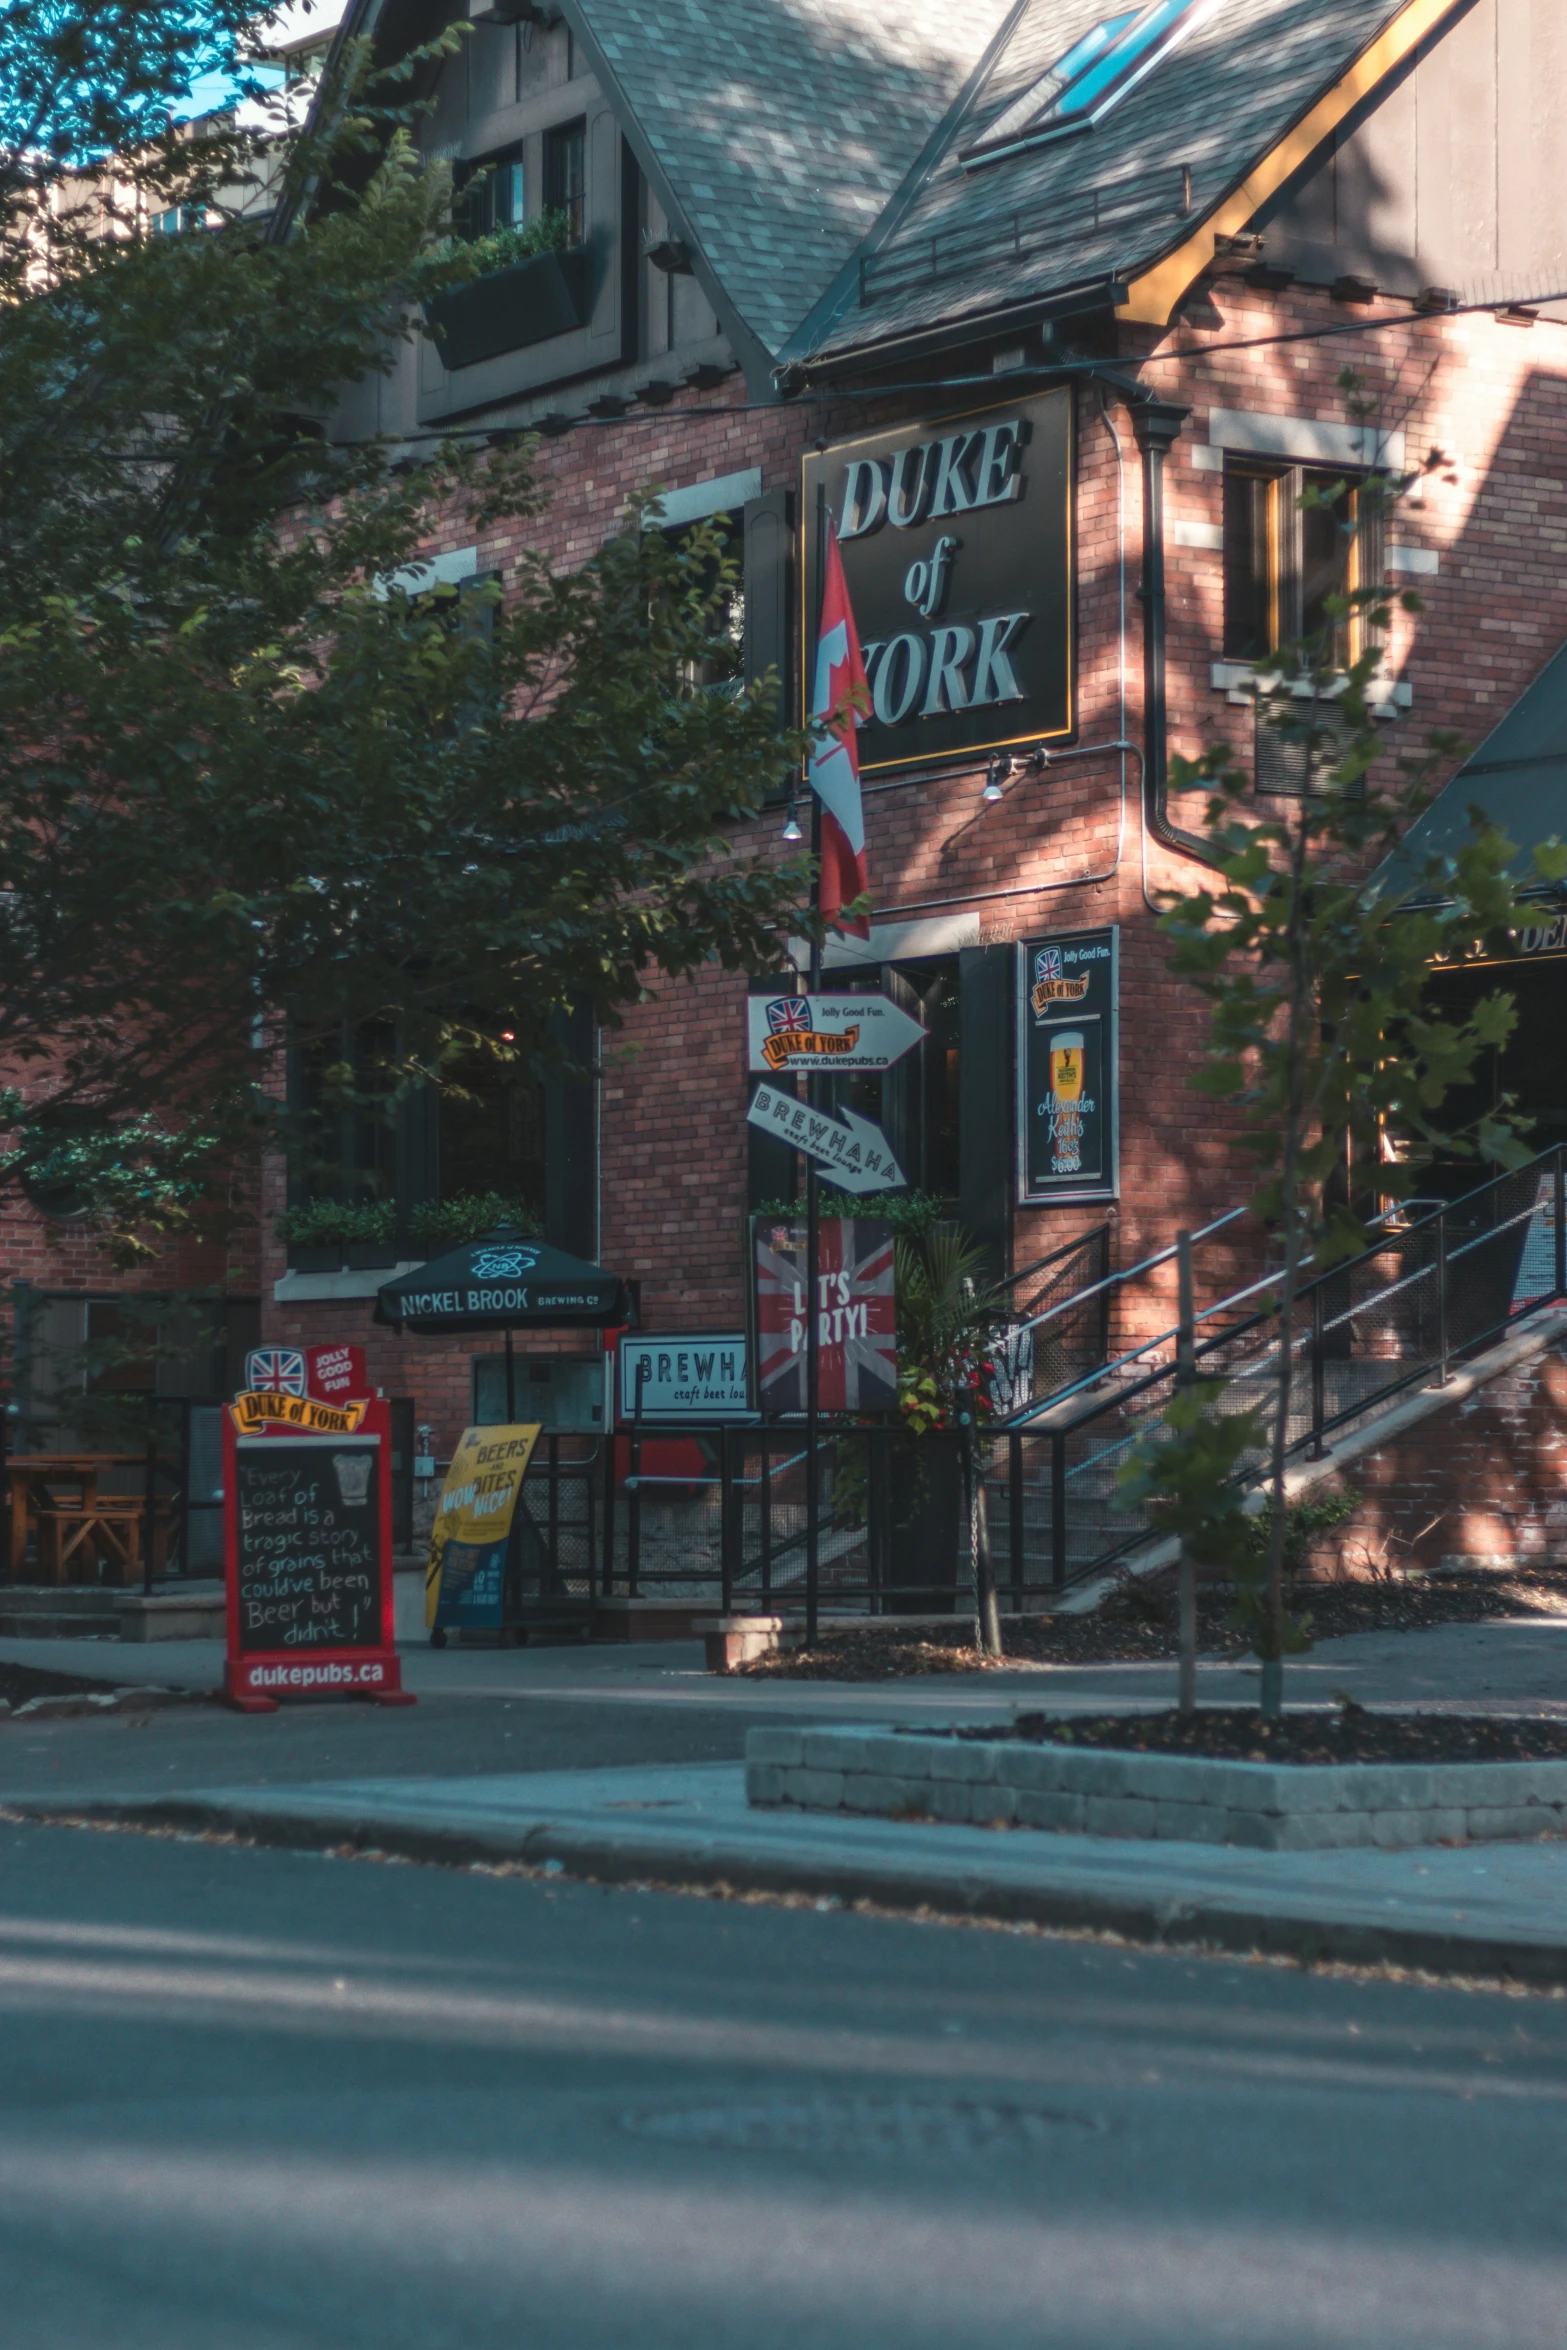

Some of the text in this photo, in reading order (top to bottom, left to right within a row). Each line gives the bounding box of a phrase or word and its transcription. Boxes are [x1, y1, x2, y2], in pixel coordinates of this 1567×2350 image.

[837, 420, 1024, 541] DUKE
[905, 537, 955, 617] of
[1064, 946, 1110, 963] Jolly Good Fun.
[1036, 982, 1084, 1003] DUKE of YORK
[821, 1007, 885, 1018] Jolly Good Fun.
[770, 1034, 851, 1057] DUKE of YORK
[790, 1055, 888, 1067] www.dukepubs.ca
[1037, 1090, 1096, 1116] Alexander
[755, 1091, 896, 1182] BREWHAHA
[1047, 1112, 1086, 1144] Keith's
[784, 1128, 863, 1175] craft beer lounge
[1051, 1155, 1082, 1174] $6.00
[400, 1291, 464, 1316] NICKEL
[467, 1287, 528, 1310] BROOK
[538, 1295, 584, 1306] BREWING
[793, 1270, 851, 1316] LT'S
[316, 1347, 350, 1368] JOLLY
[317, 1361, 353, 1380] GOOD
[324, 1377, 350, 1392] FUN
[674, 1386, 747, 1405] craft beer lou
[245, 1395, 351, 1431] DUKE of YORK
[476, 1438, 528, 1465] BEERS
[240, 1482, 319, 1508] Loaf of
[442, 1483, 477, 1514] WOW
[242, 1506, 335, 1530] Bread is a
[244, 1528, 359, 1554] tragic story
[243, 1543, 373, 1578] of grains that
[241, 1570, 370, 1598] could've been
[245, 1591, 341, 1629] Beer but
[250, 1662, 384, 1687] dukepubs.ca
